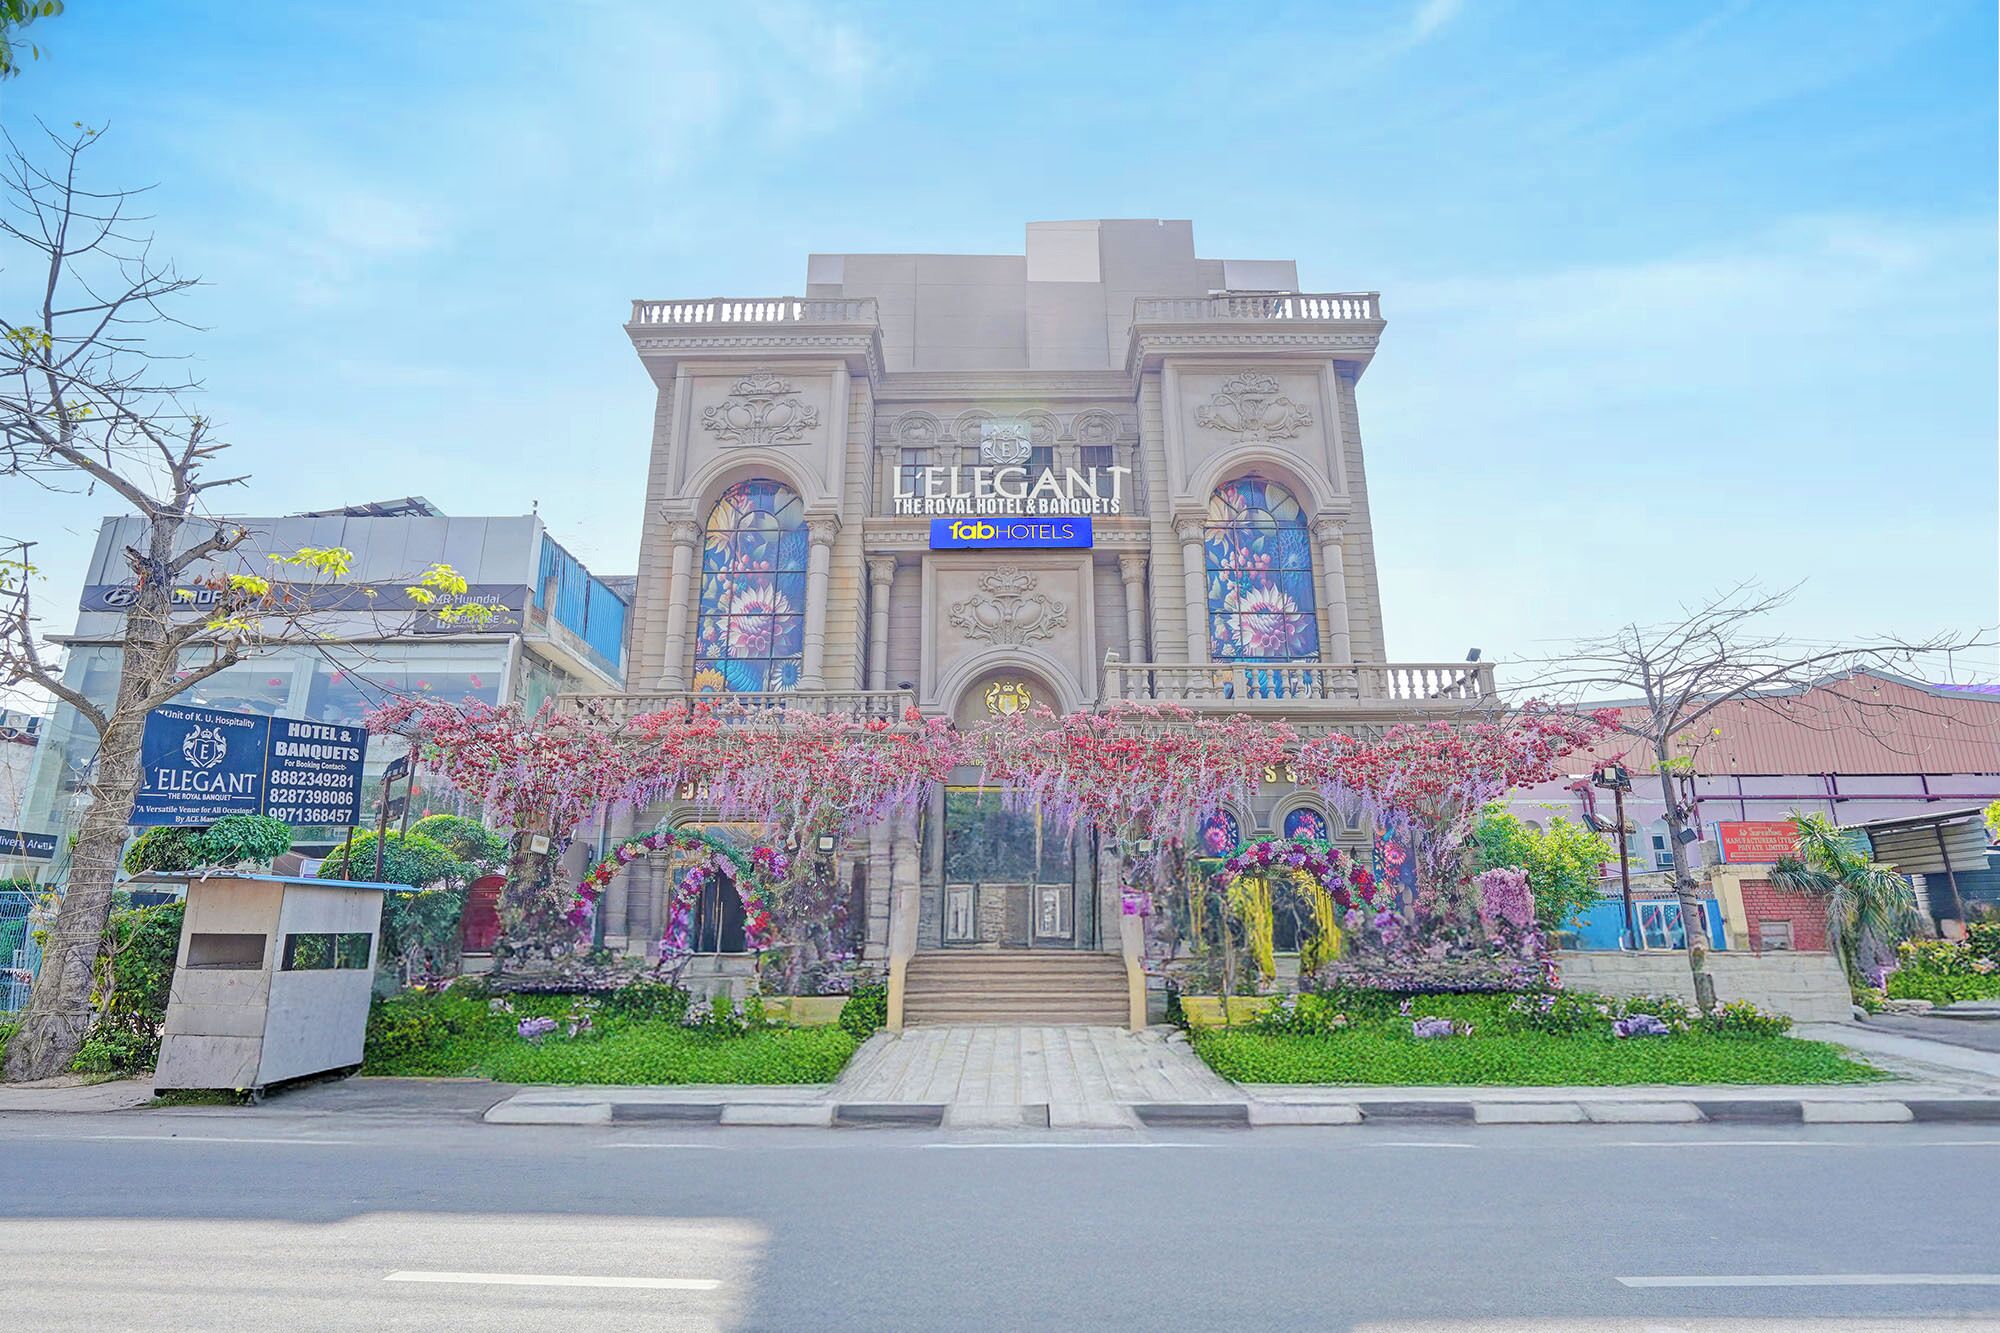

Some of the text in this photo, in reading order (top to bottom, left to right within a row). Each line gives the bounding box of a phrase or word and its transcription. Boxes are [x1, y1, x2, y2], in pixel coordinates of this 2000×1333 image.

[1002, 442, 1011, 457] E
[893, 466, 1131, 499] L'ELEGANT
[894, 498, 1120, 514] THE ROYAL HOTEL & BANQUETS
[185, 711, 194, 720] of
[215, 716, 255, 729] Hospitality
[288, 722, 352, 742] HOTEL &
[201, 743, 208, 760] E
[275, 741, 359, 762] BANQUETS
[284, 759, 295, 767] For
[296, 760, 320, 770] Booking
[270, 769, 354, 788] 8882349281
[168, 792, 180, 800] THE
[203, 793, 232, 801] BANQUET
[269, 788, 353, 805] 8287398086
[145, 805, 177, 813] Versatile
[201, 806, 211, 814] for
[212, 806, 221, 814] All
[268, 807, 353, 823] 9971368457
[175, 815, 184, 824] By
